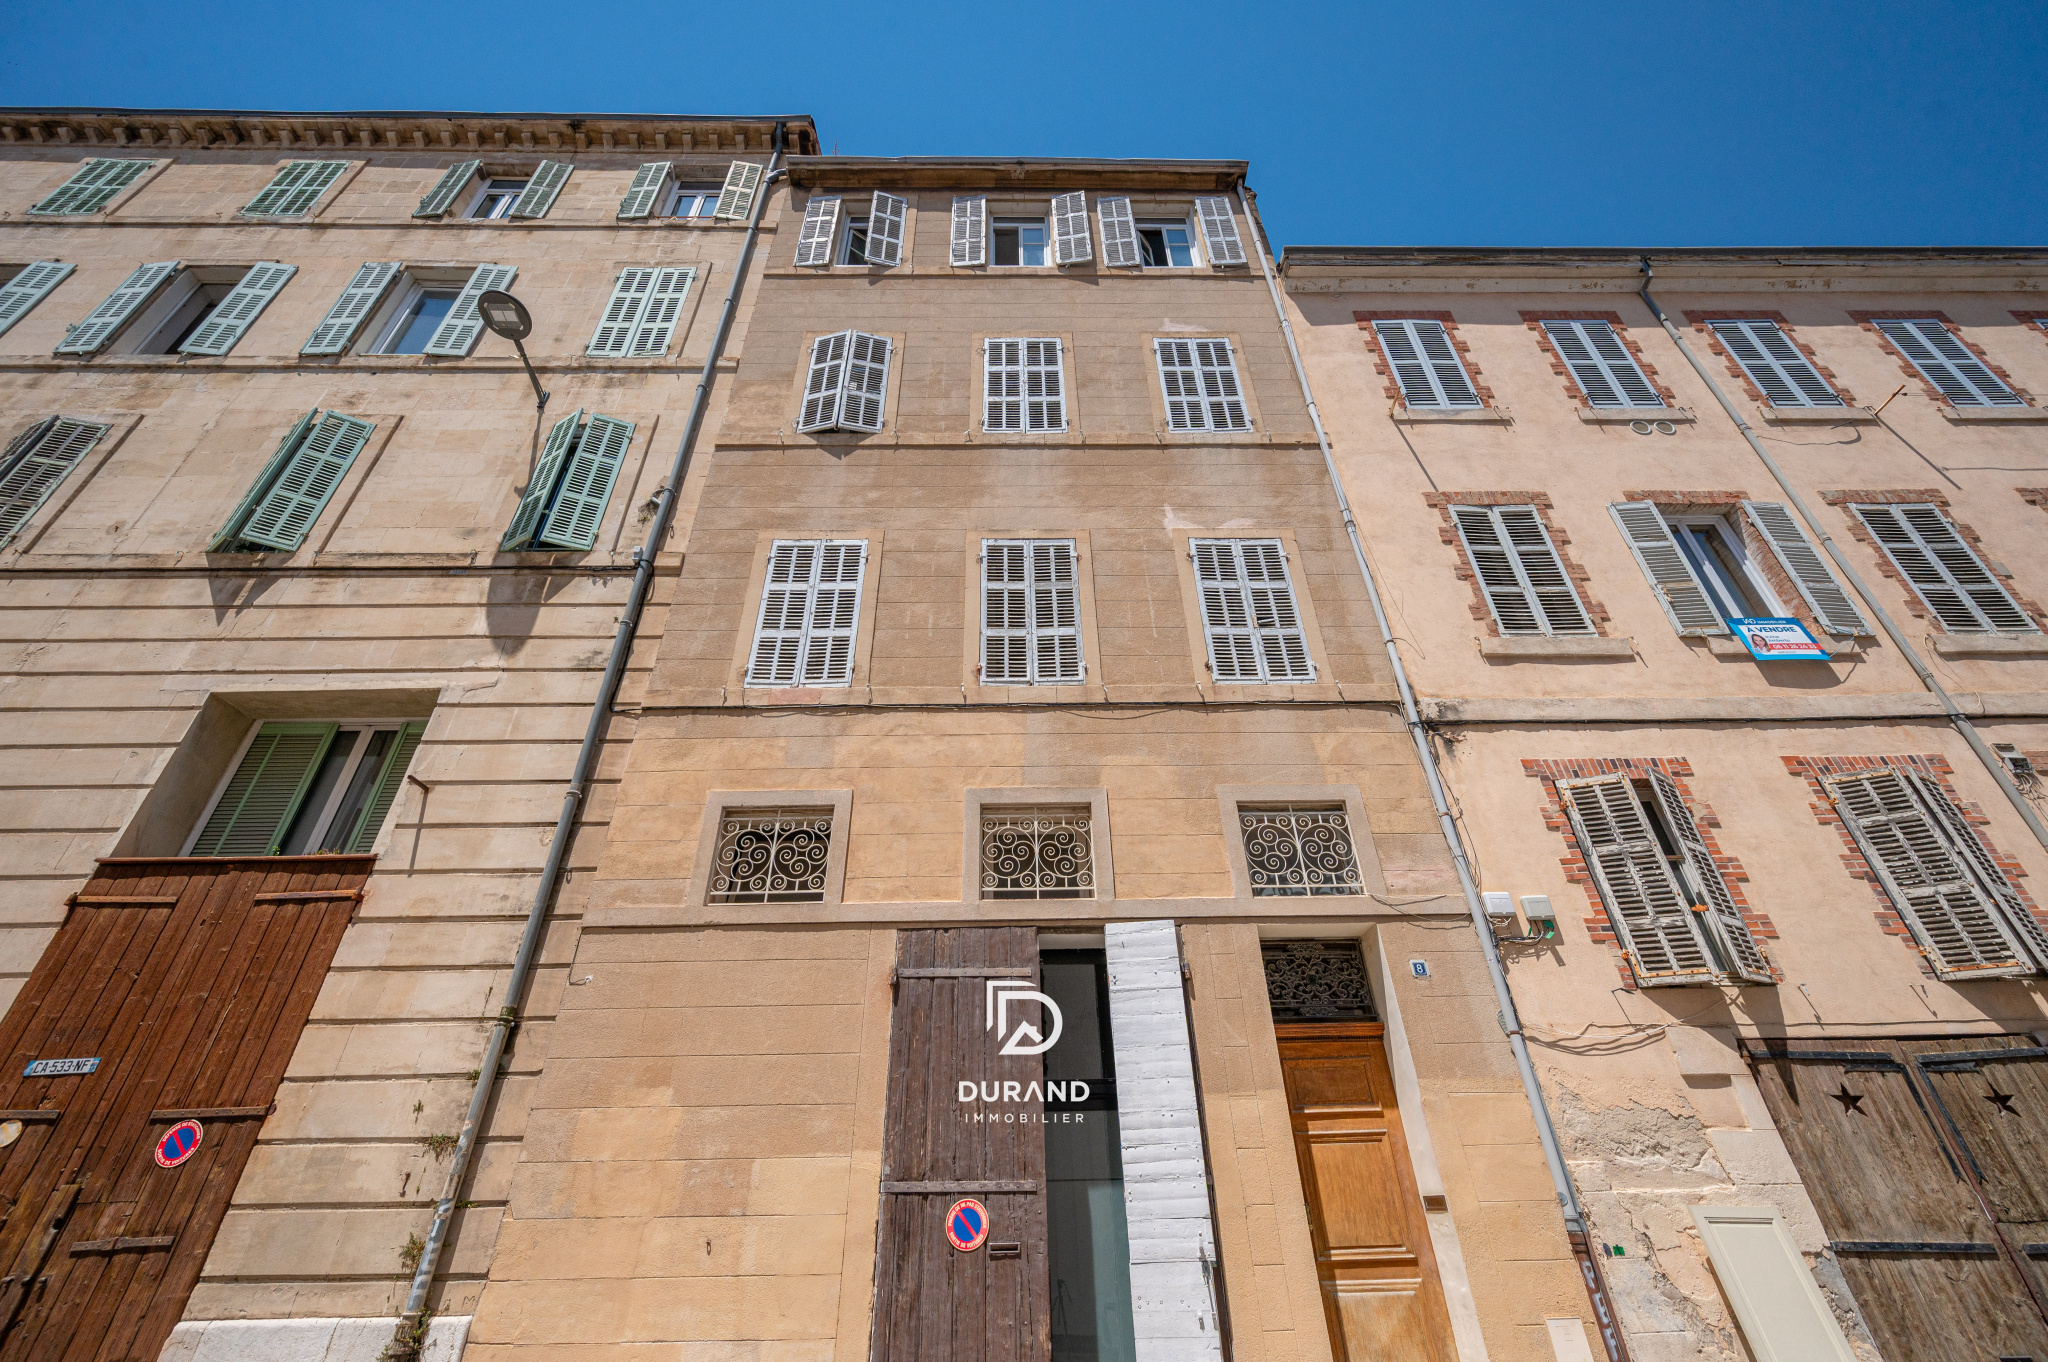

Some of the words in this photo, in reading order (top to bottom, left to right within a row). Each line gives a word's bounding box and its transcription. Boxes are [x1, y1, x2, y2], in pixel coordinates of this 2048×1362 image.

[1416, 964, 1423, 973] 8
[33, 1059, 91, 1074] CA-533-NF
[188, 1122, 200, 1139] STATIONNER
[157, 1149, 165, 1163] SORTIE
[172, 1147, 195, 1164] VOITURES
[974, 1204, 987, 1228] STATIONNER
[949, 1232, 960, 1246] SORTIE
[966, 1234, 984, 1248] VOITURES
